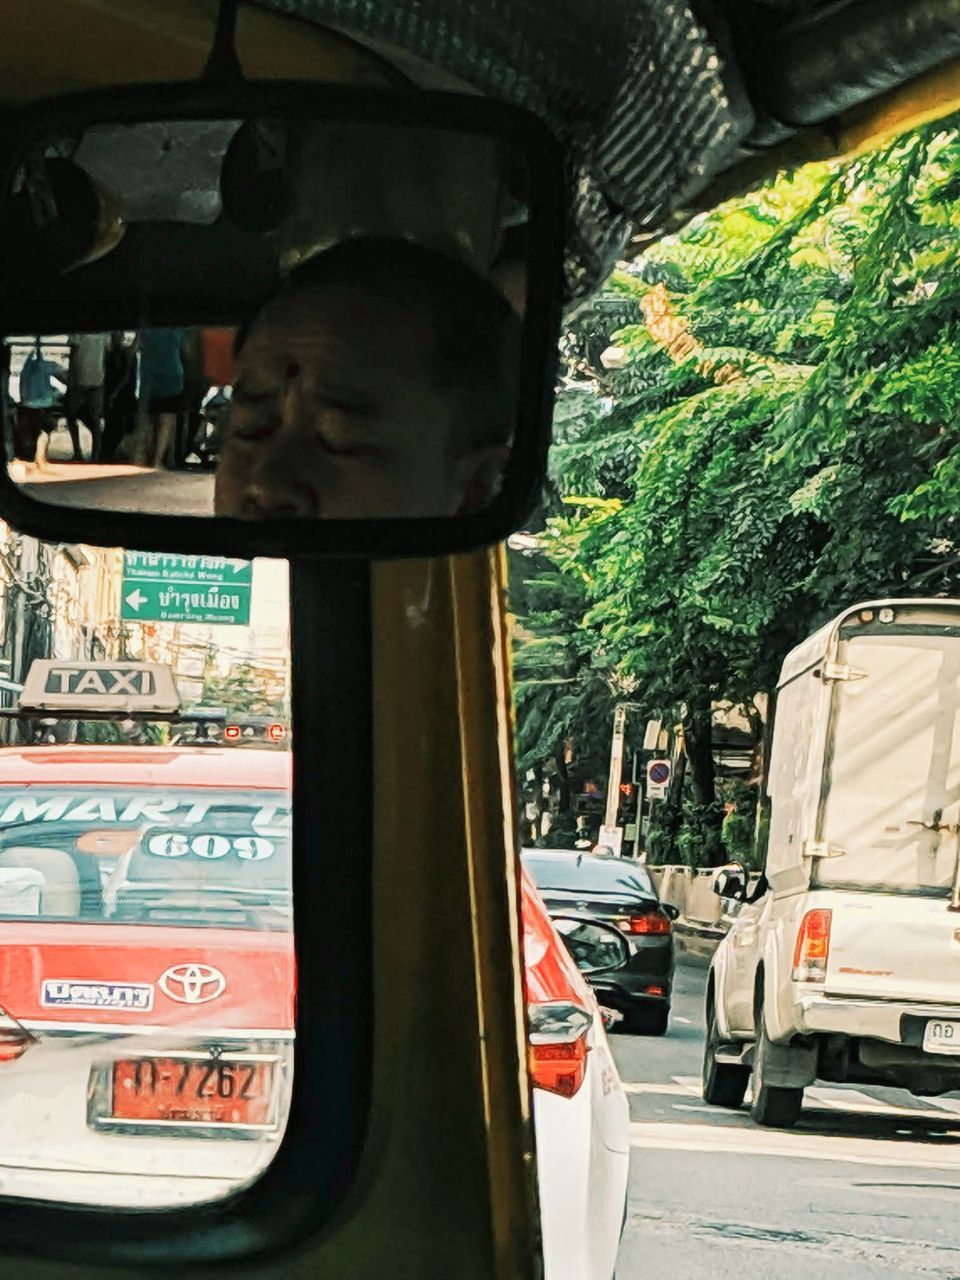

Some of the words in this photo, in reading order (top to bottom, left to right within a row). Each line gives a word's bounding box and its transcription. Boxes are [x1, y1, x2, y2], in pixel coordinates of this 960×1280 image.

[158, 586, 240, 613] บำรุงเมือง
[50, 670, 151, 694] TAXI
[148, 833, 274, 861] 609
